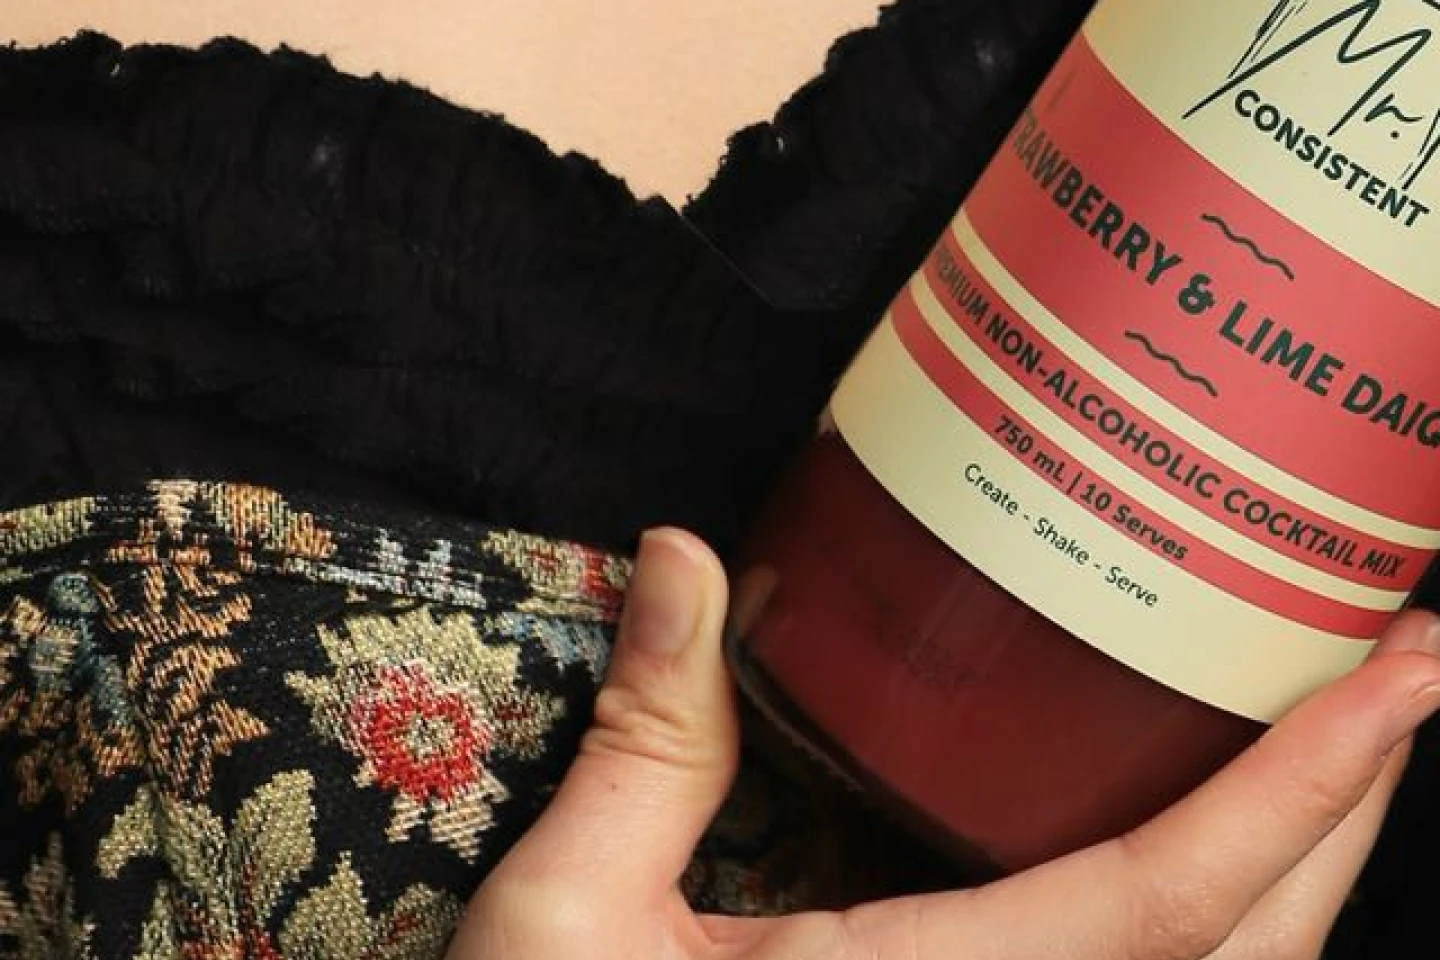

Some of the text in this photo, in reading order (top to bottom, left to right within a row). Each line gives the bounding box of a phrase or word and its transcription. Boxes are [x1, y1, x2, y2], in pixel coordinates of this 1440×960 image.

[1235, 90, 1430, 228] CONSISTENT
[1178, 273, 1216, 315] &
[1219, 300, 1346, 397] LIME
[985, 313, 1222, 500] NON-ALCOHOLIC
[1222, 487, 1359, 569] COCKTAIL
[1359, 549, 1407, 578] MIX
[995, 415, 1034, 455] 750
[1033, 450, 1066, 484] mL
[1080, 483, 1112, 512] 10
[1113, 504, 1188, 560] Serves
[964, 463, 1018, 515] Create
[1033, 517, 1090, 565] Shake
[1105, 566, 1158, 607] Serve
